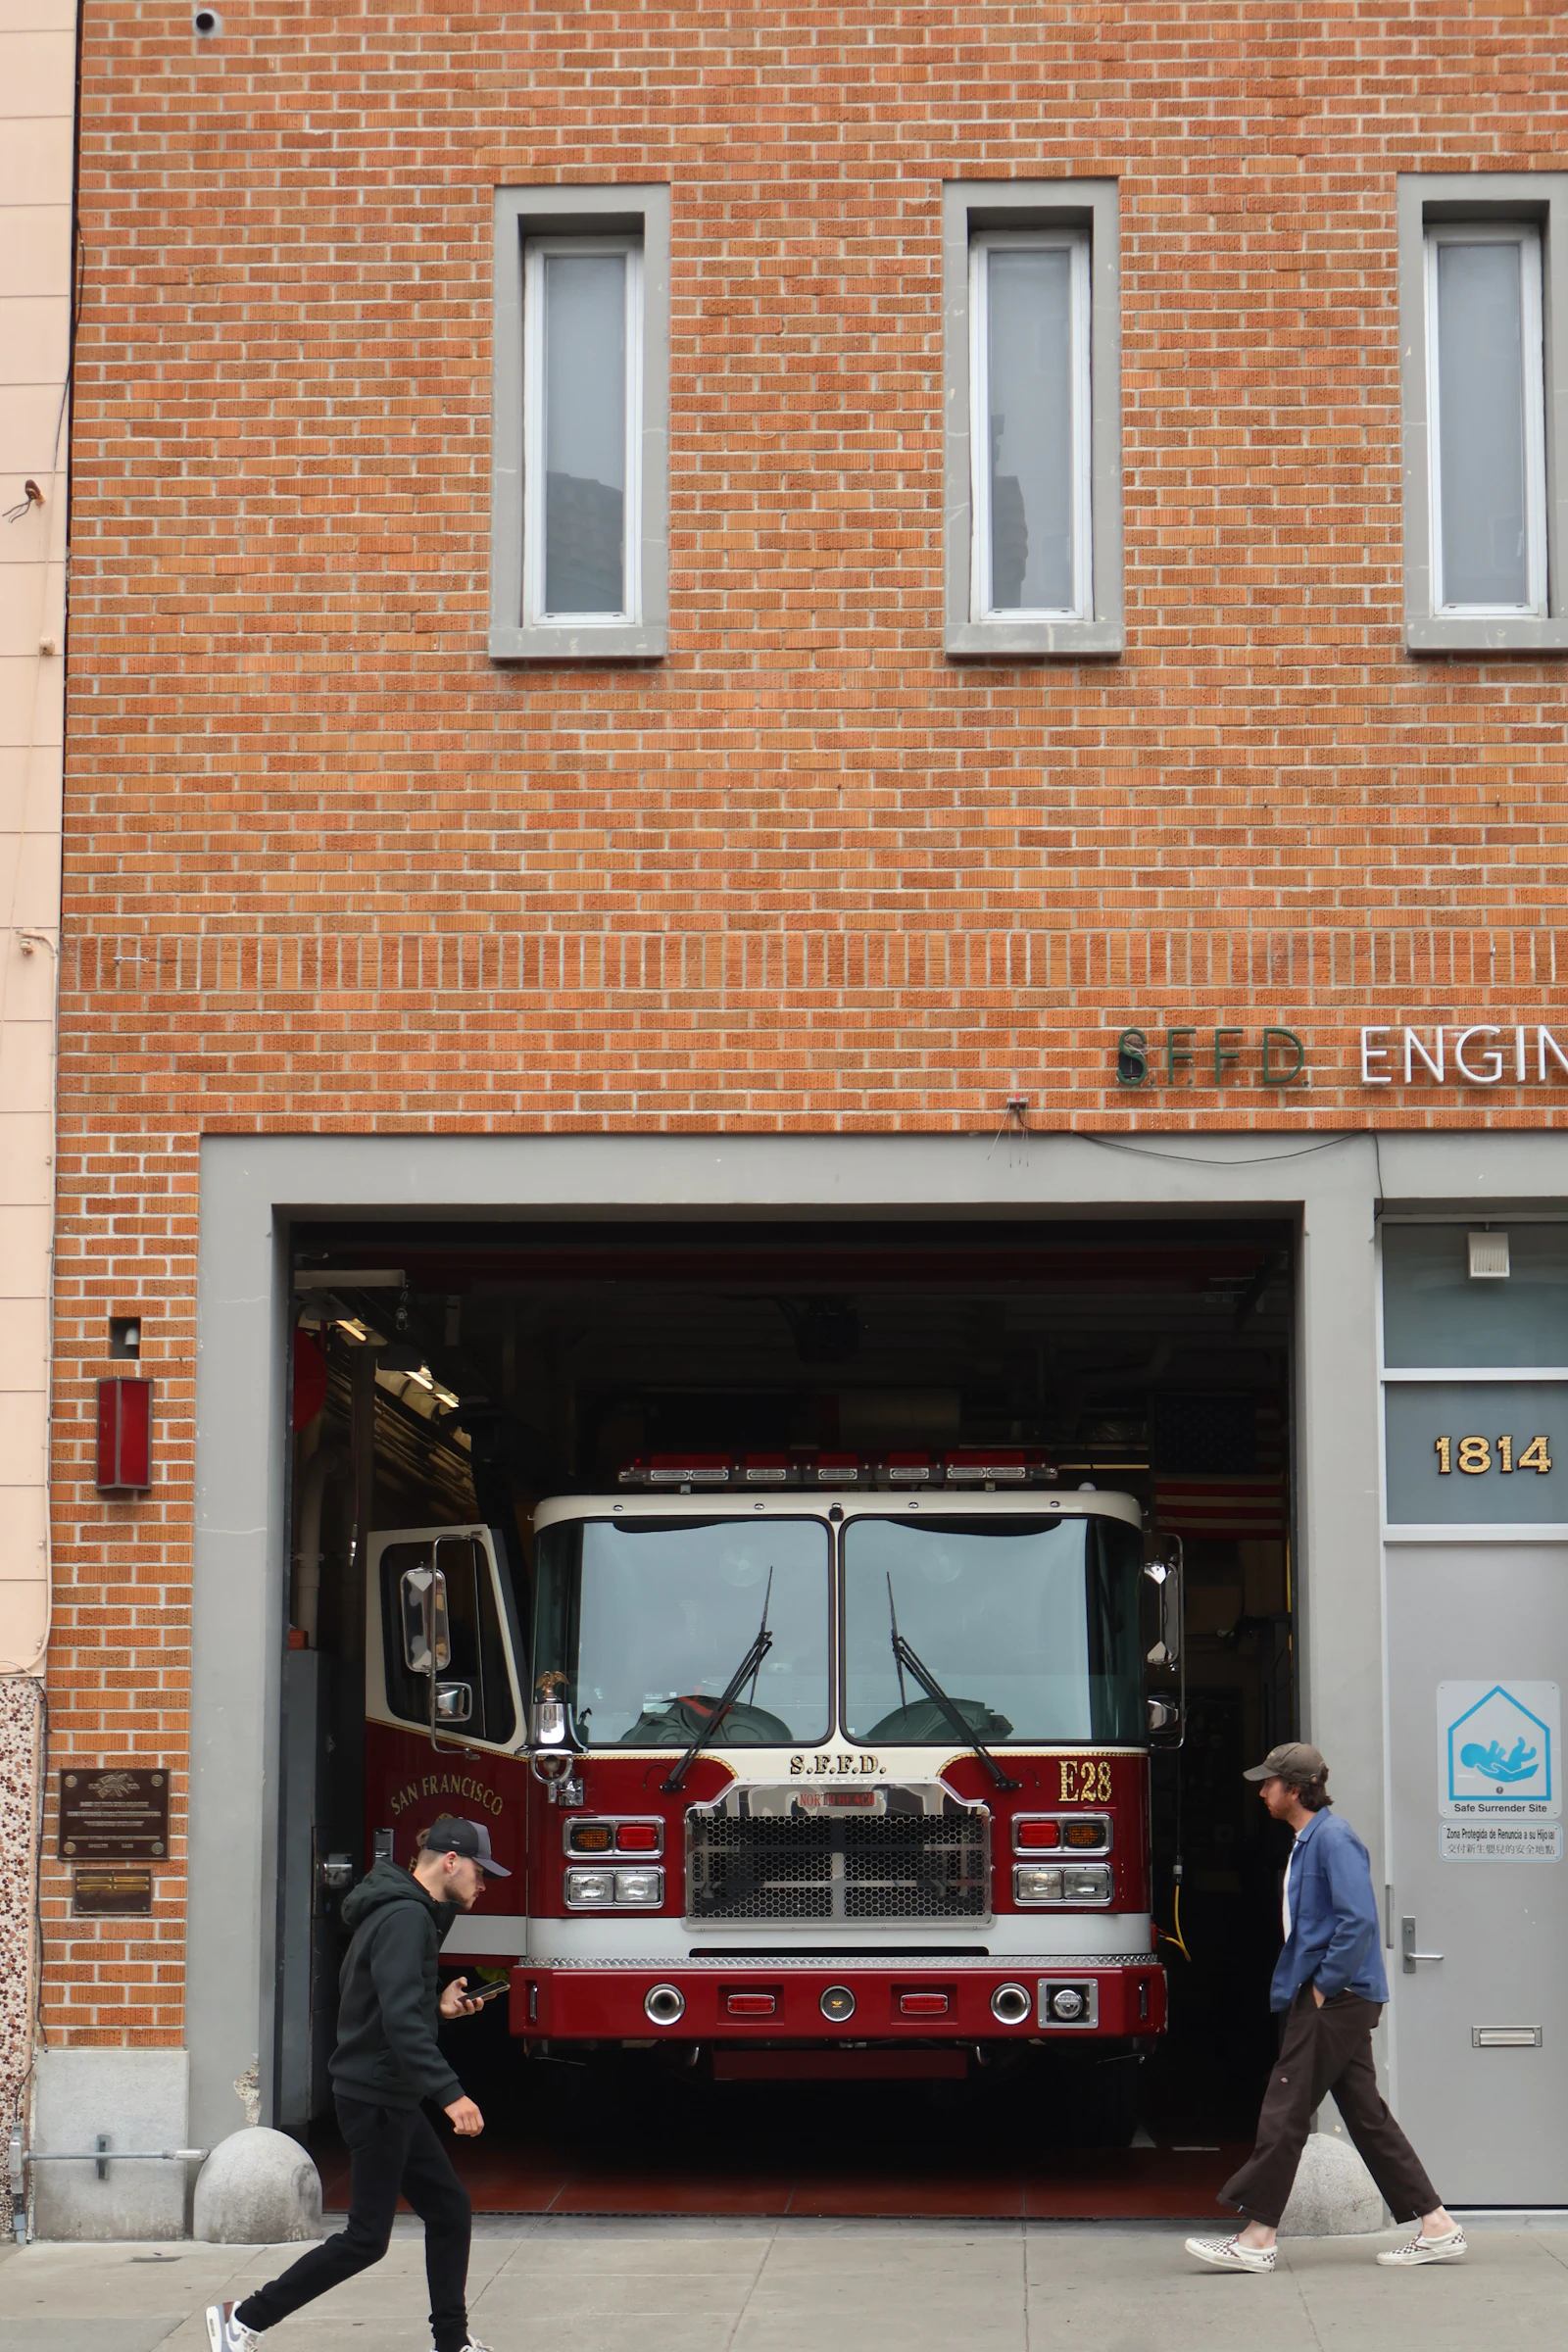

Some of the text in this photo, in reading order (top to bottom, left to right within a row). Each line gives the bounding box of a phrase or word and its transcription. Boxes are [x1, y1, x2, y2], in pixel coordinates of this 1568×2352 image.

[1434, 1434, 1552, 1475] 1814
[790, 1754, 887, 1775] S.F.F.D.
[1057, 1760, 1112, 1802] E28
[390, 1774, 504, 1816] SAN FRANCISCO
[800, 1792, 836, 1806] NORTH
[1454, 1803, 1547, 1813] Safe Surrender Site
[1446, 1828, 1460, 1839] Zona
[1461, 1828, 1488, 1841] Protegida
[1489, 1828, 1496, 1839] de
[1497, 1828, 1522, 1839] Renuncia
[1529, 1831, 1536, 1839] su
